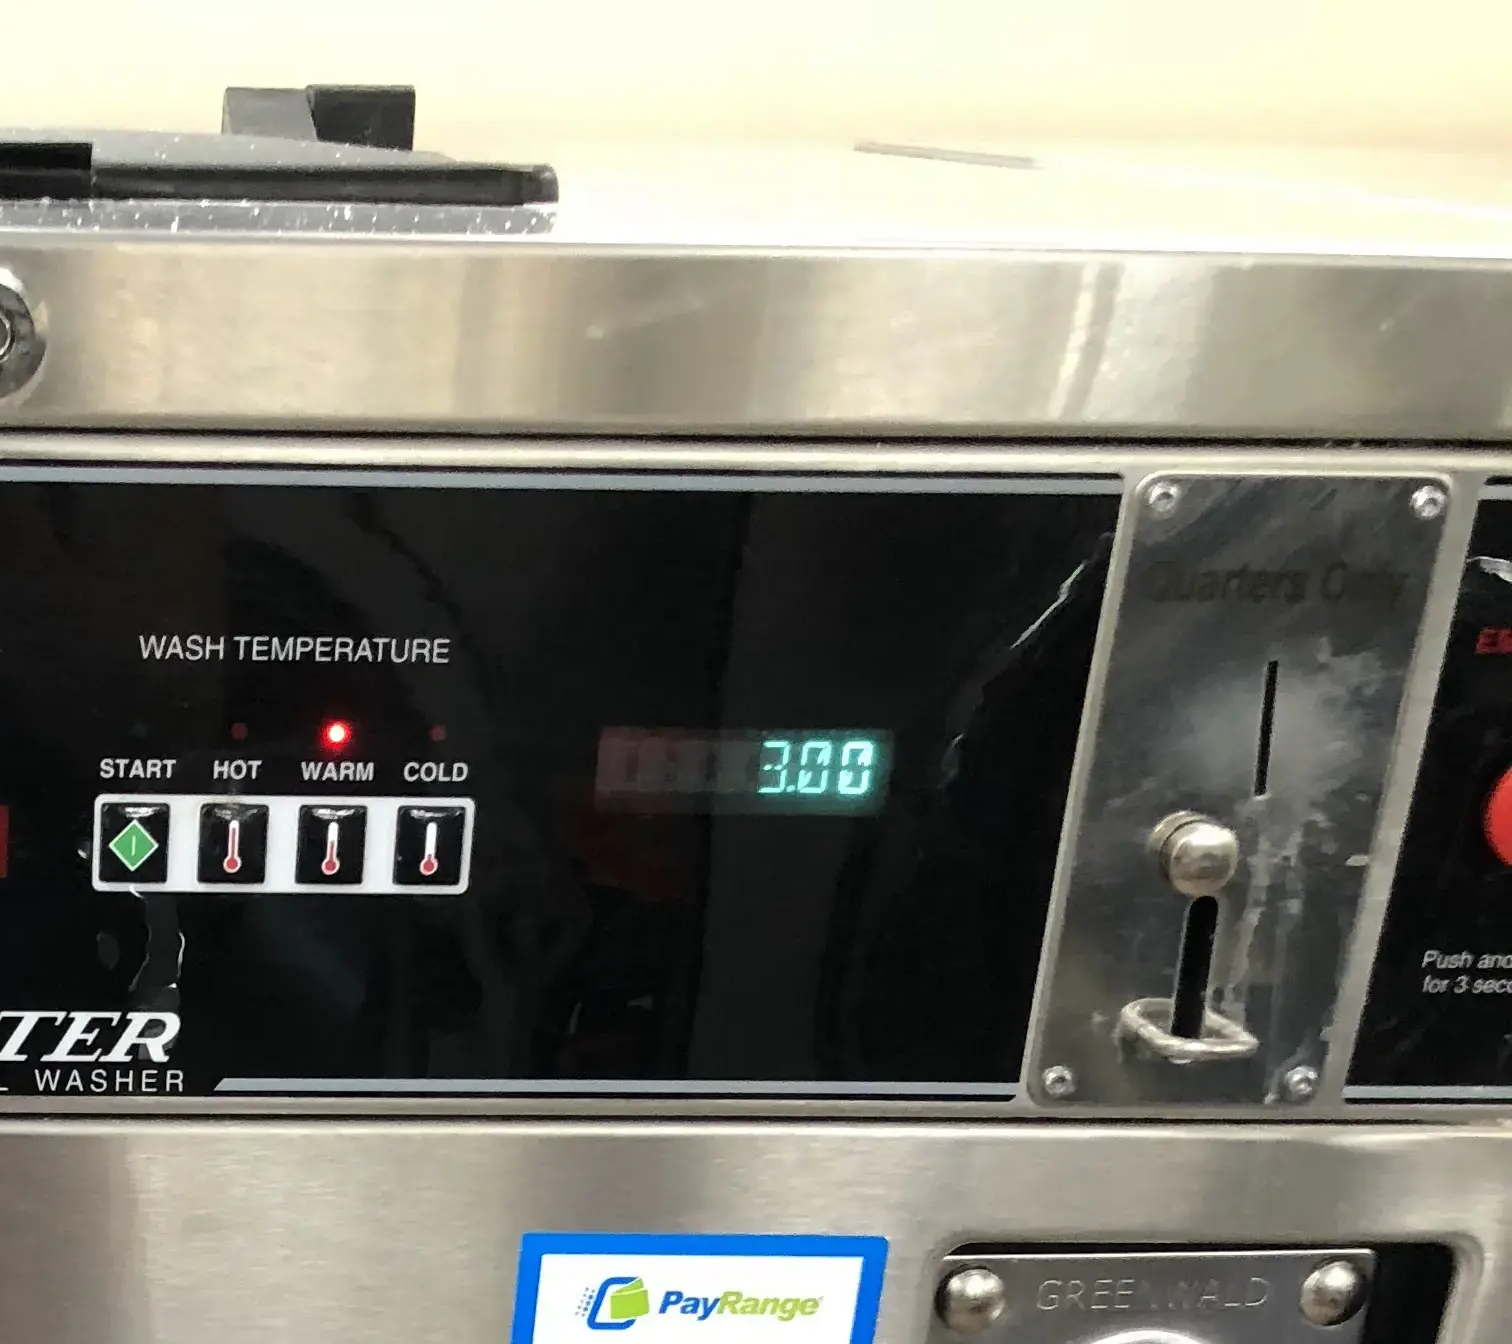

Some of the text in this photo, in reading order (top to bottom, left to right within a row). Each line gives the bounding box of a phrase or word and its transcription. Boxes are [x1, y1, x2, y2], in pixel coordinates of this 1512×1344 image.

[139, 634, 450, 664] WASH TEMPERATURE
[99, 758, 176, 780] START
[212, 759, 262, 780] HOT
[301, 761, 375, 782] WARM
[403, 761, 469, 782] COLD
[756, 740, 875, 794] 3.00
[1421, 949, 1475, 969] Push
[1422, 974, 1450, 994] for
[1453, 975, 1470, 994] 3
[34, 1068, 185, 1093] WASHER
